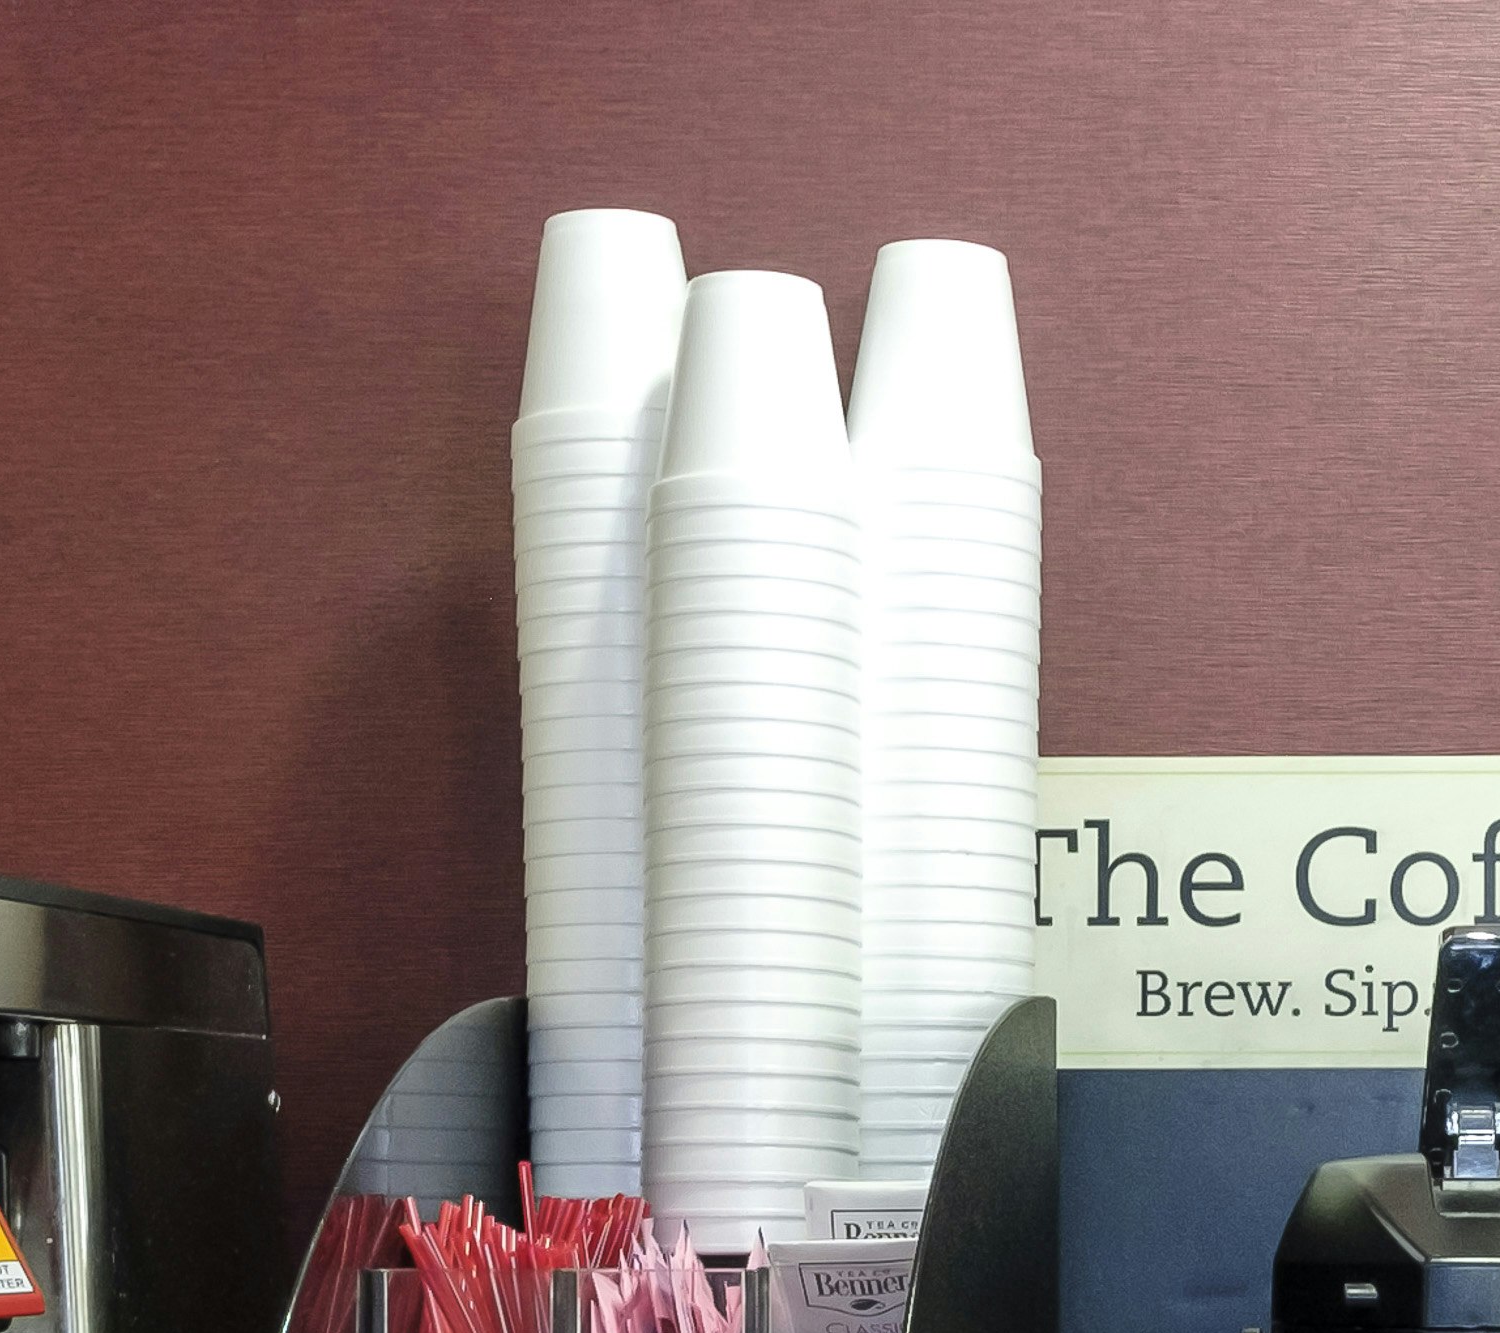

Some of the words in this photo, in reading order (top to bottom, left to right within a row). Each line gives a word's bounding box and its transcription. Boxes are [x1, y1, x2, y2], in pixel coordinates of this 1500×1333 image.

[1035, 818, 1245, 927] The
[1135, 970, 1301, 1018] Brew.
[1324, 965, 1431, 1032] Sip.
